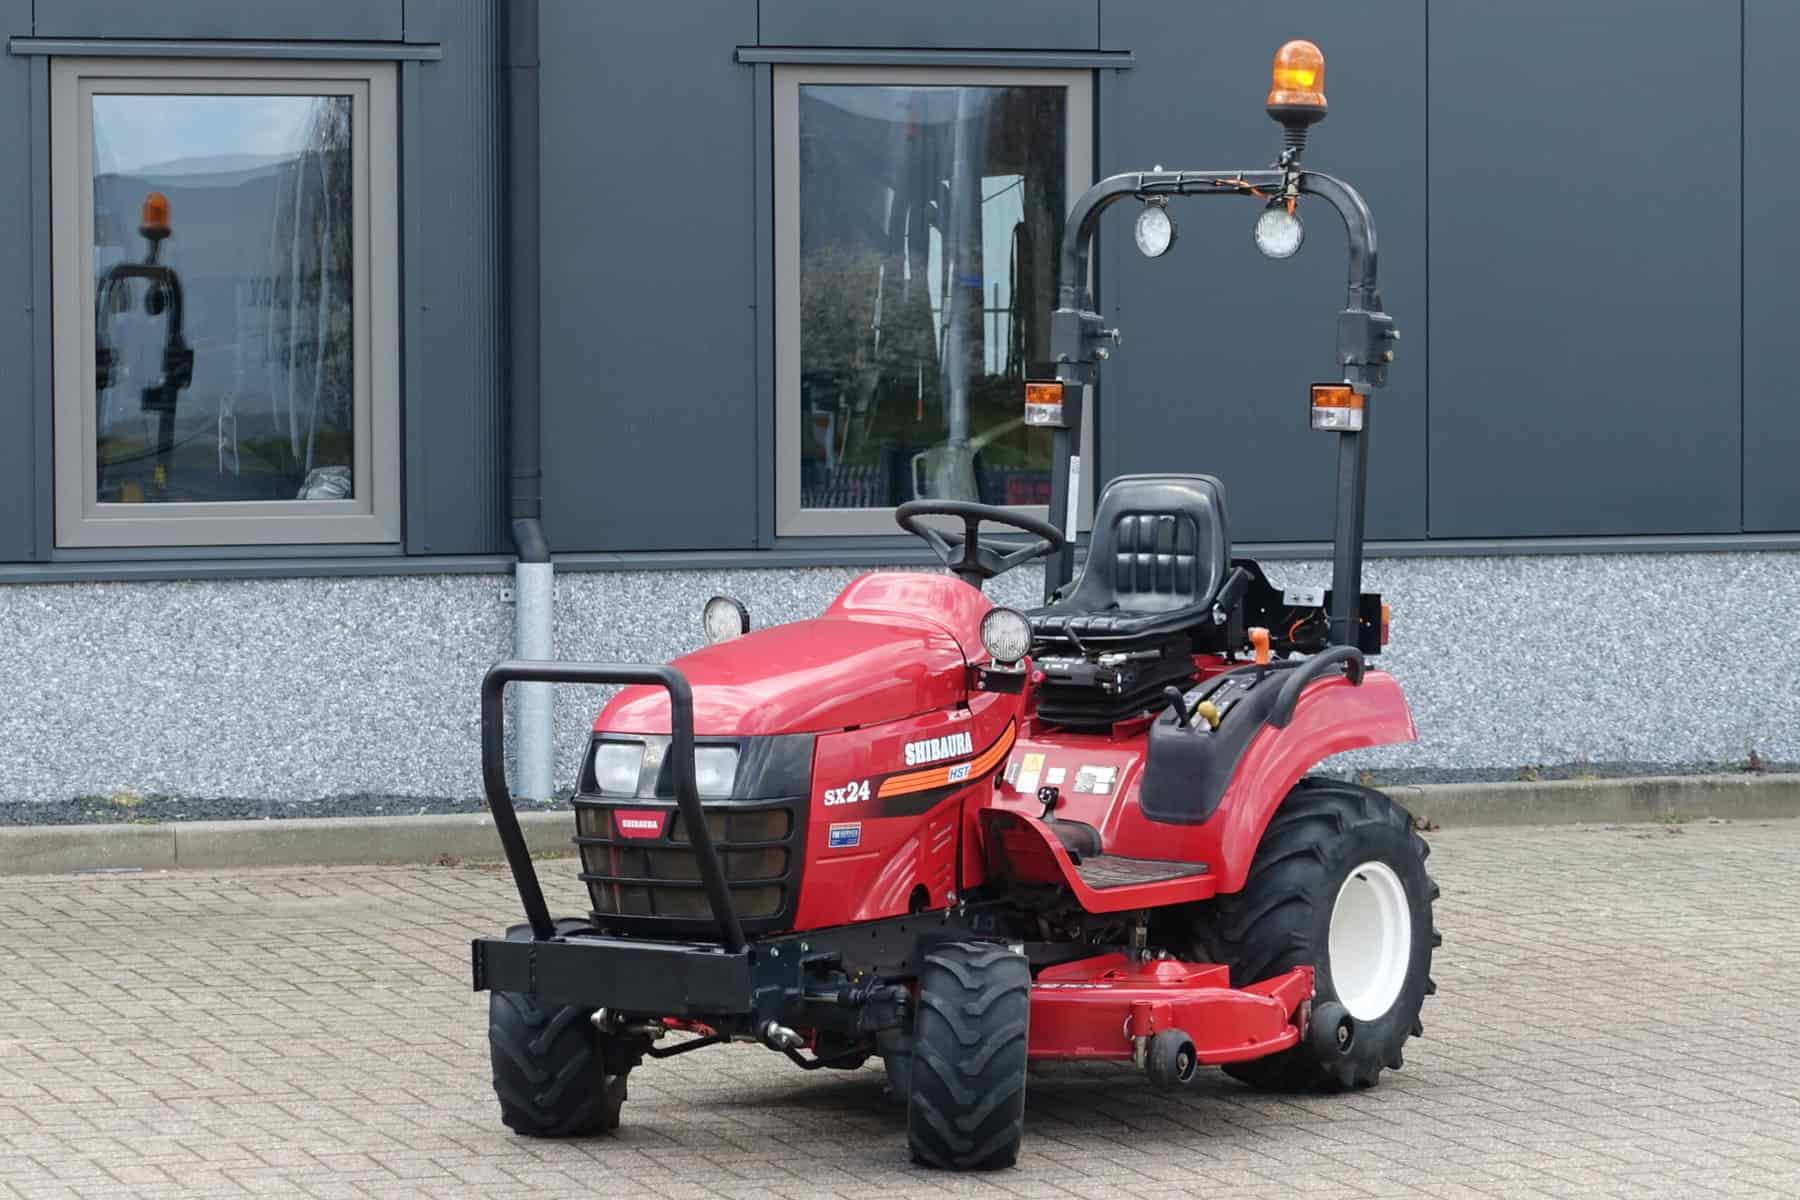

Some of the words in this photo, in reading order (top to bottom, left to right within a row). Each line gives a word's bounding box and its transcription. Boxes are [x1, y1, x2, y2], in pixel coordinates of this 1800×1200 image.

[904, 731, 973, 766] SHIBAURA
[949, 766, 971, 779] HST
[824, 779, 870, 806] SX24
